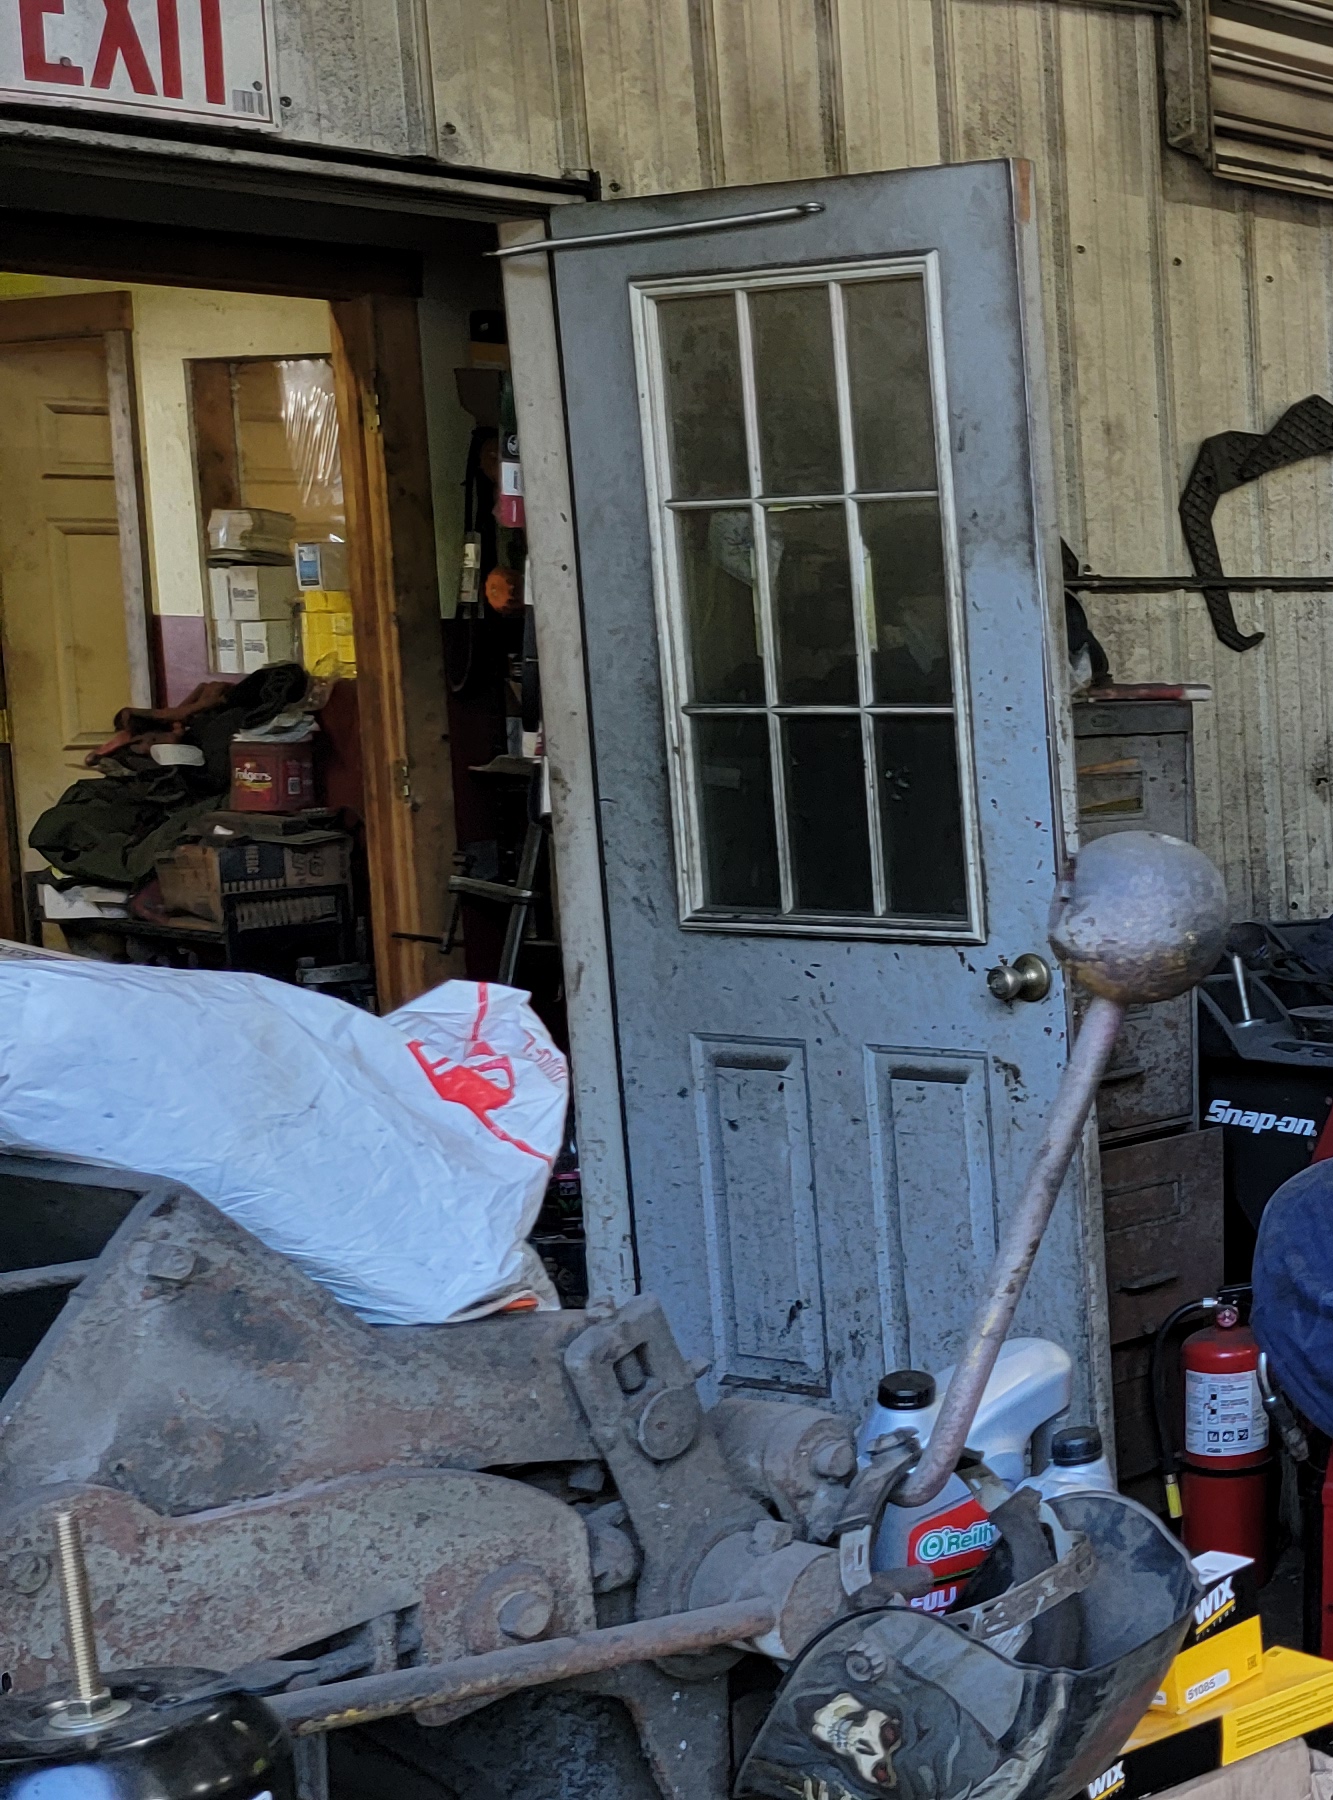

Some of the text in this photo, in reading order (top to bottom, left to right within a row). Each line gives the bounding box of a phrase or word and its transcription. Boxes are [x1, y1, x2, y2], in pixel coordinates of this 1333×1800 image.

[1204, 1100, 1315, 1135] Snap-on
[1195, 1575, 1235, 1625] WIX
[1088, 1760, 1126, 1799] WIX
